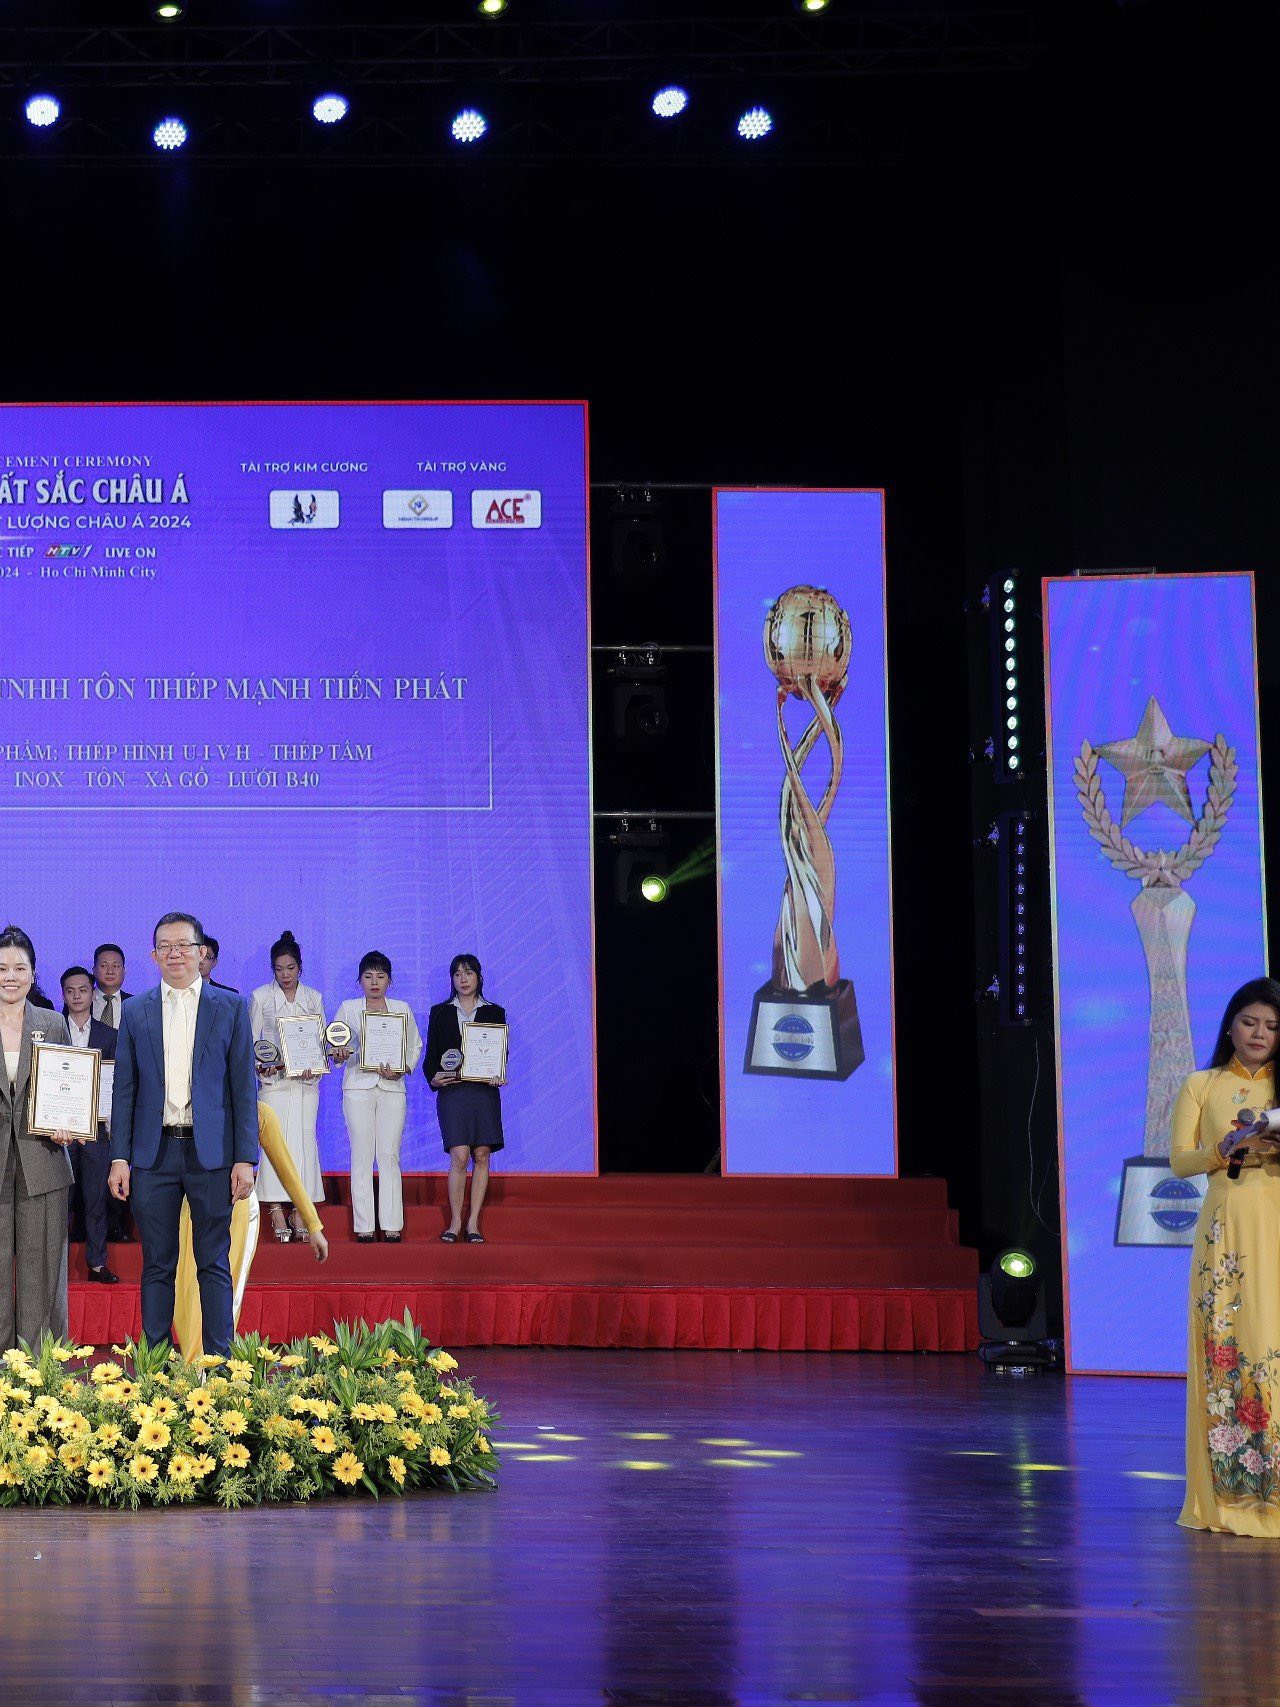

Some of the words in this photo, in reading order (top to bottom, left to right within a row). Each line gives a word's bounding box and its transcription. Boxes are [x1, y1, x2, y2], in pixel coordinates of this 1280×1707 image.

[64, 455, 153, 467] CEREMONY
[240, 461, 261, 472] TÀI
[264, 462, 290, 474] TRỢ
[294, 463, 317, 472] KIM
[321, 462, 368, 472] CƯƠNG
[416, 460, 437, 471] TÀI
[441, 461, 467, 473] TRỢ
[470, 460, 507, 471] VÀNG
[36, 470, 85, 504] SẮC
[92, 473, 163, 504] CHÂU
[169, 473, 189, 504] Á
[485, 498, 525, 520] ACE
[7, 514, 70, 532] LƯỢNG
[76, 513, 126, 529] CHÂU
[132, 513, 144, 529] Á
[149, 515, 192, 529] 2024
[7, 544, 34, 558] TIẾP
[105, 548, 131, 558] LIVE
[135, 548, 156, 558] ON
[40, 567, 59, 578] Ho
[63, 566, 87, 578] Chi
[91, 567, 125, 578] Minh
[129, 566, 157, 580] City
[78, 672, 136, 700] TÔN
[145, 671, 218, 700] THÉP
[224, 678, 312, 705] MẠNH
[320, 671, 382, 700] TIẾN
[394, 672, 468, 700] PHÁT
[66, 742, 118, 761] THÉP
[122, 741, 174, 761] HÌNH
[270, 741, 324, 761] THÉP
[15, 771, 64, 787] INOX
[84, 766, 125, 787] TÔN
[145, 767, 173, 787] XÀ
[228, 767, 277, 788] LƯỚI
[286, 772, 319, 788] B40
